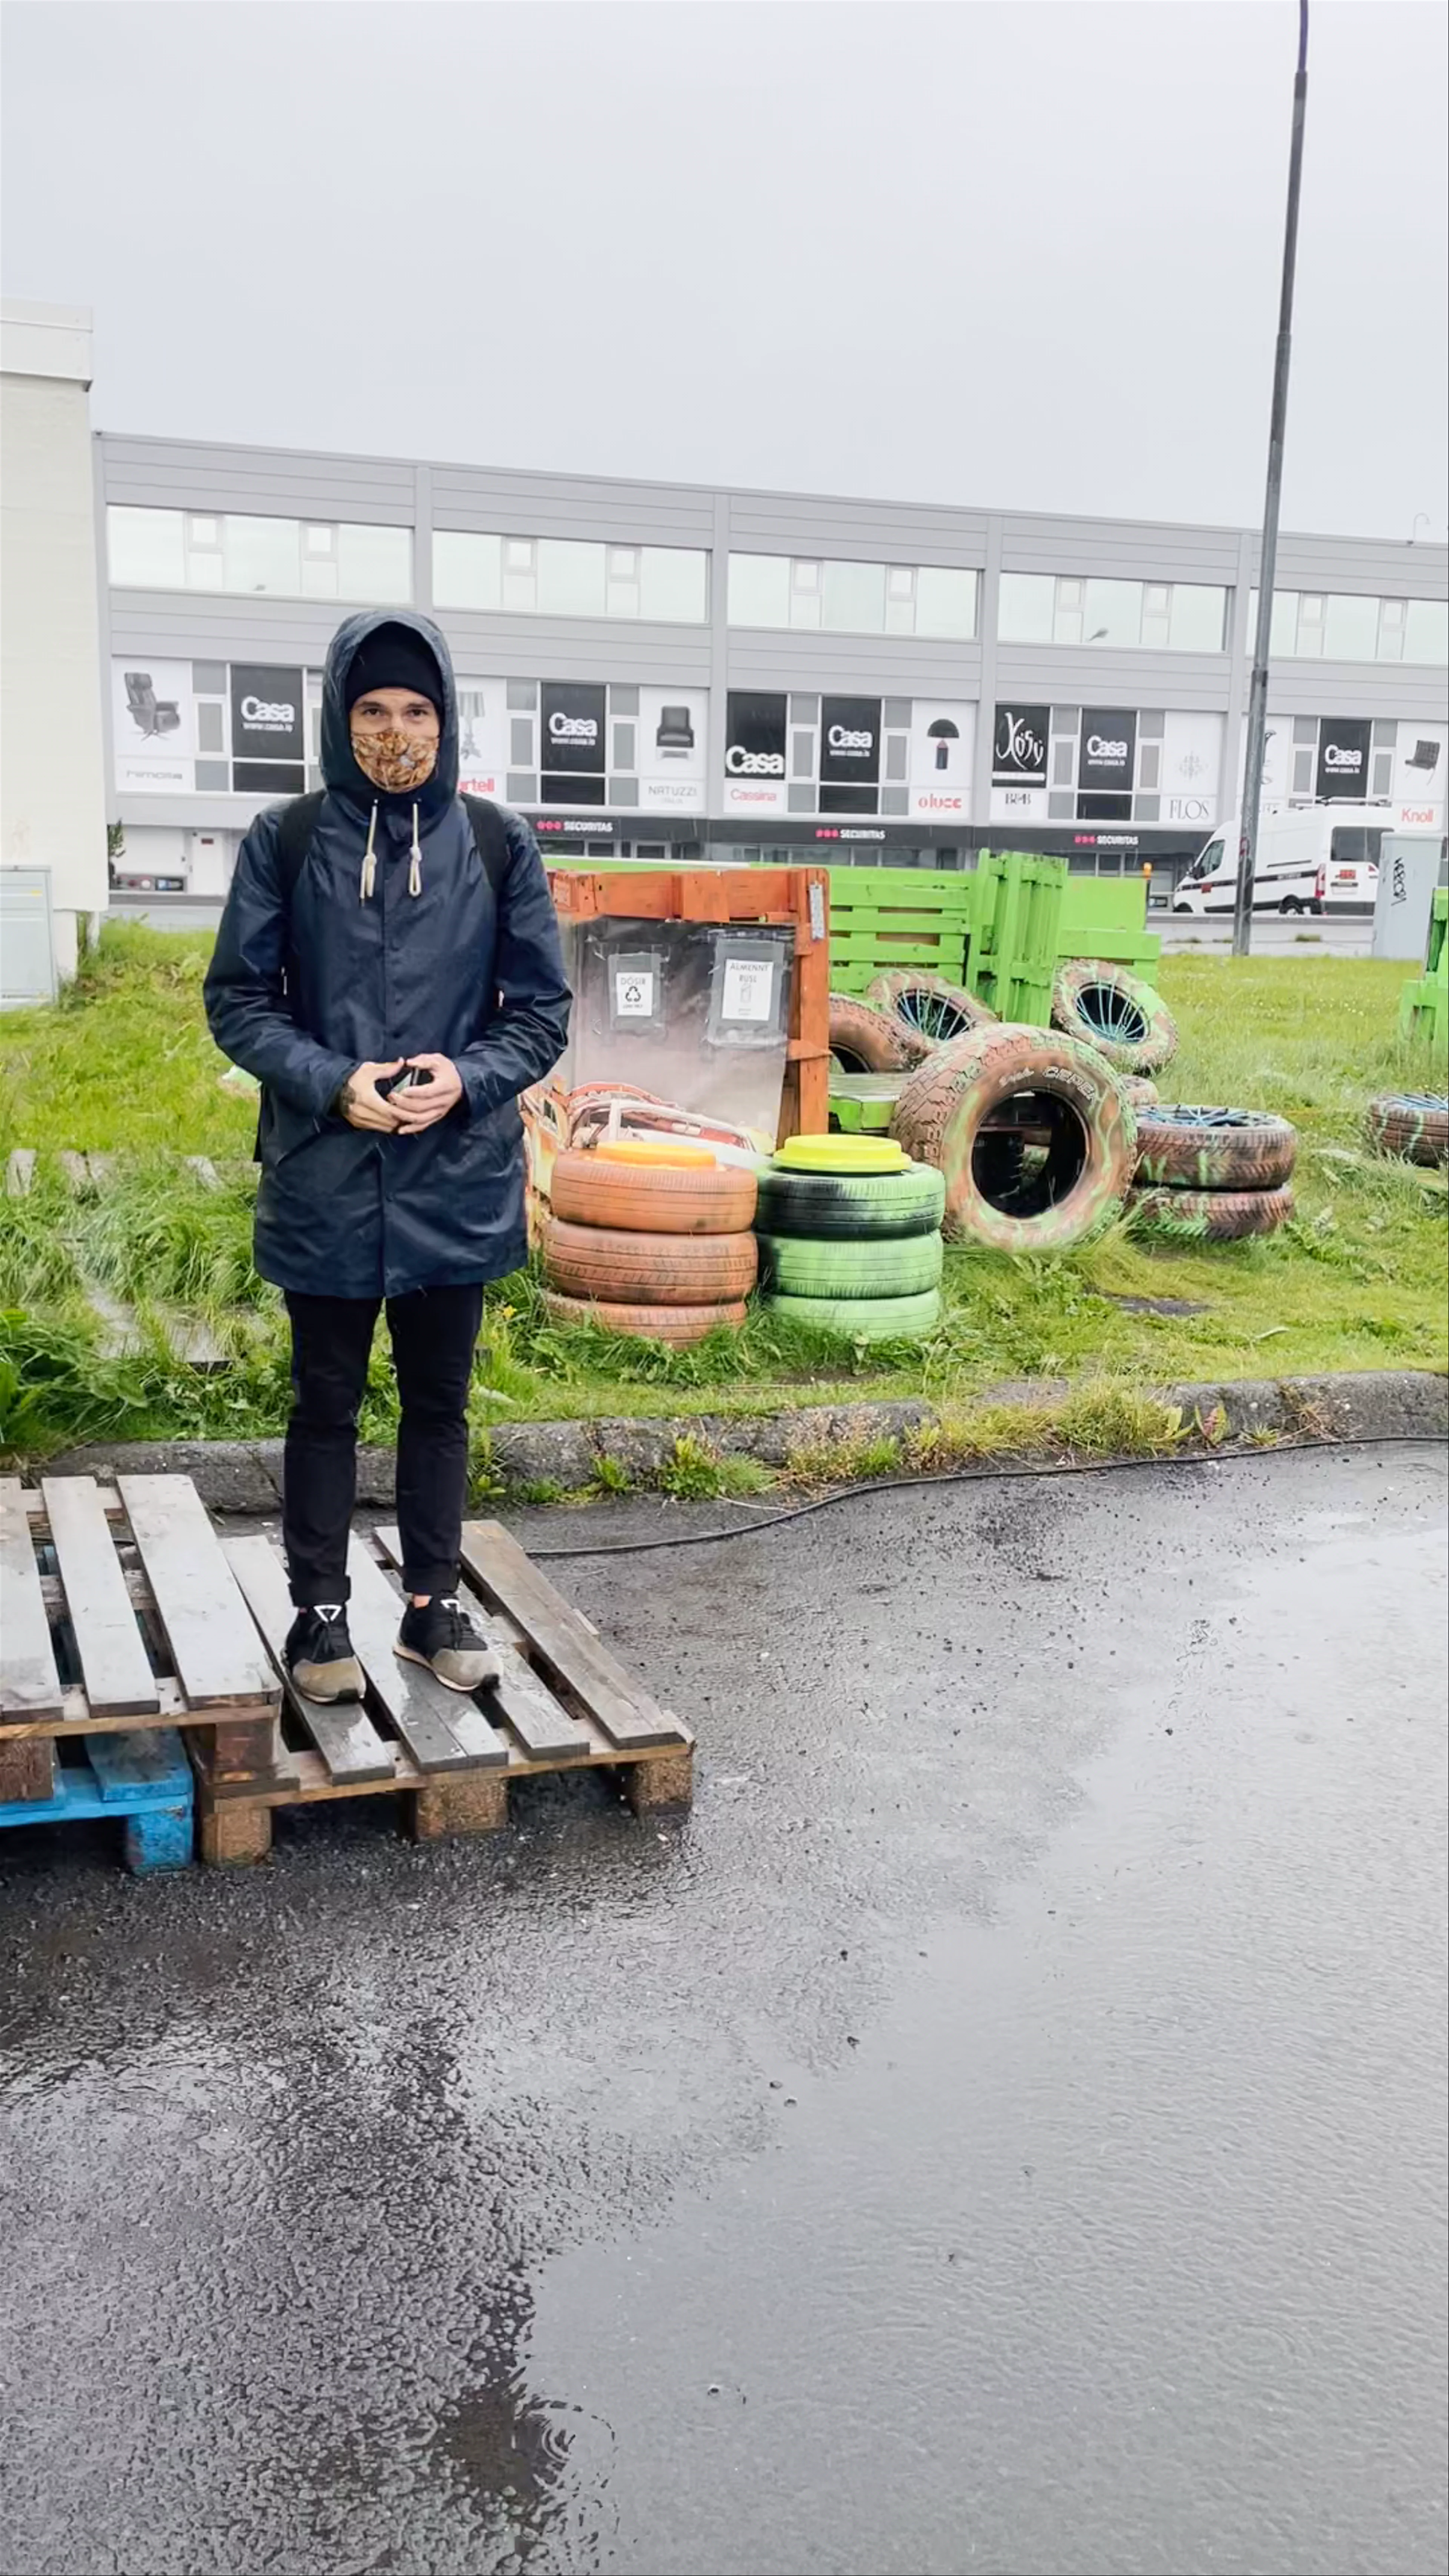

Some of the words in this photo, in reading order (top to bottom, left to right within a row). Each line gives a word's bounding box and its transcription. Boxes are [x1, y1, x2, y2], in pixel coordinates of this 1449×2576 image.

[241, 696, 294, 721] Casa
[549, 713, 597, 737] Casa
[829, 725, 872, 748] Casa
[1088, 736, 1127, 757] Casa
[1325, 745, 1362, 766] Casa
[726, 745, 784, 773] Casa
[458, 778, 494, 792] artell
[648, 786, 697, 796] NATUZZI
[731, 788, 777, 801] Cassina
[1170, 800, 1209, 819] FLOS
[1401, 808, 1433, 823] Knoll
[564, 821, 613, 832] SECURITAS
[1097, 835, 1138, 845] SECURITAS
